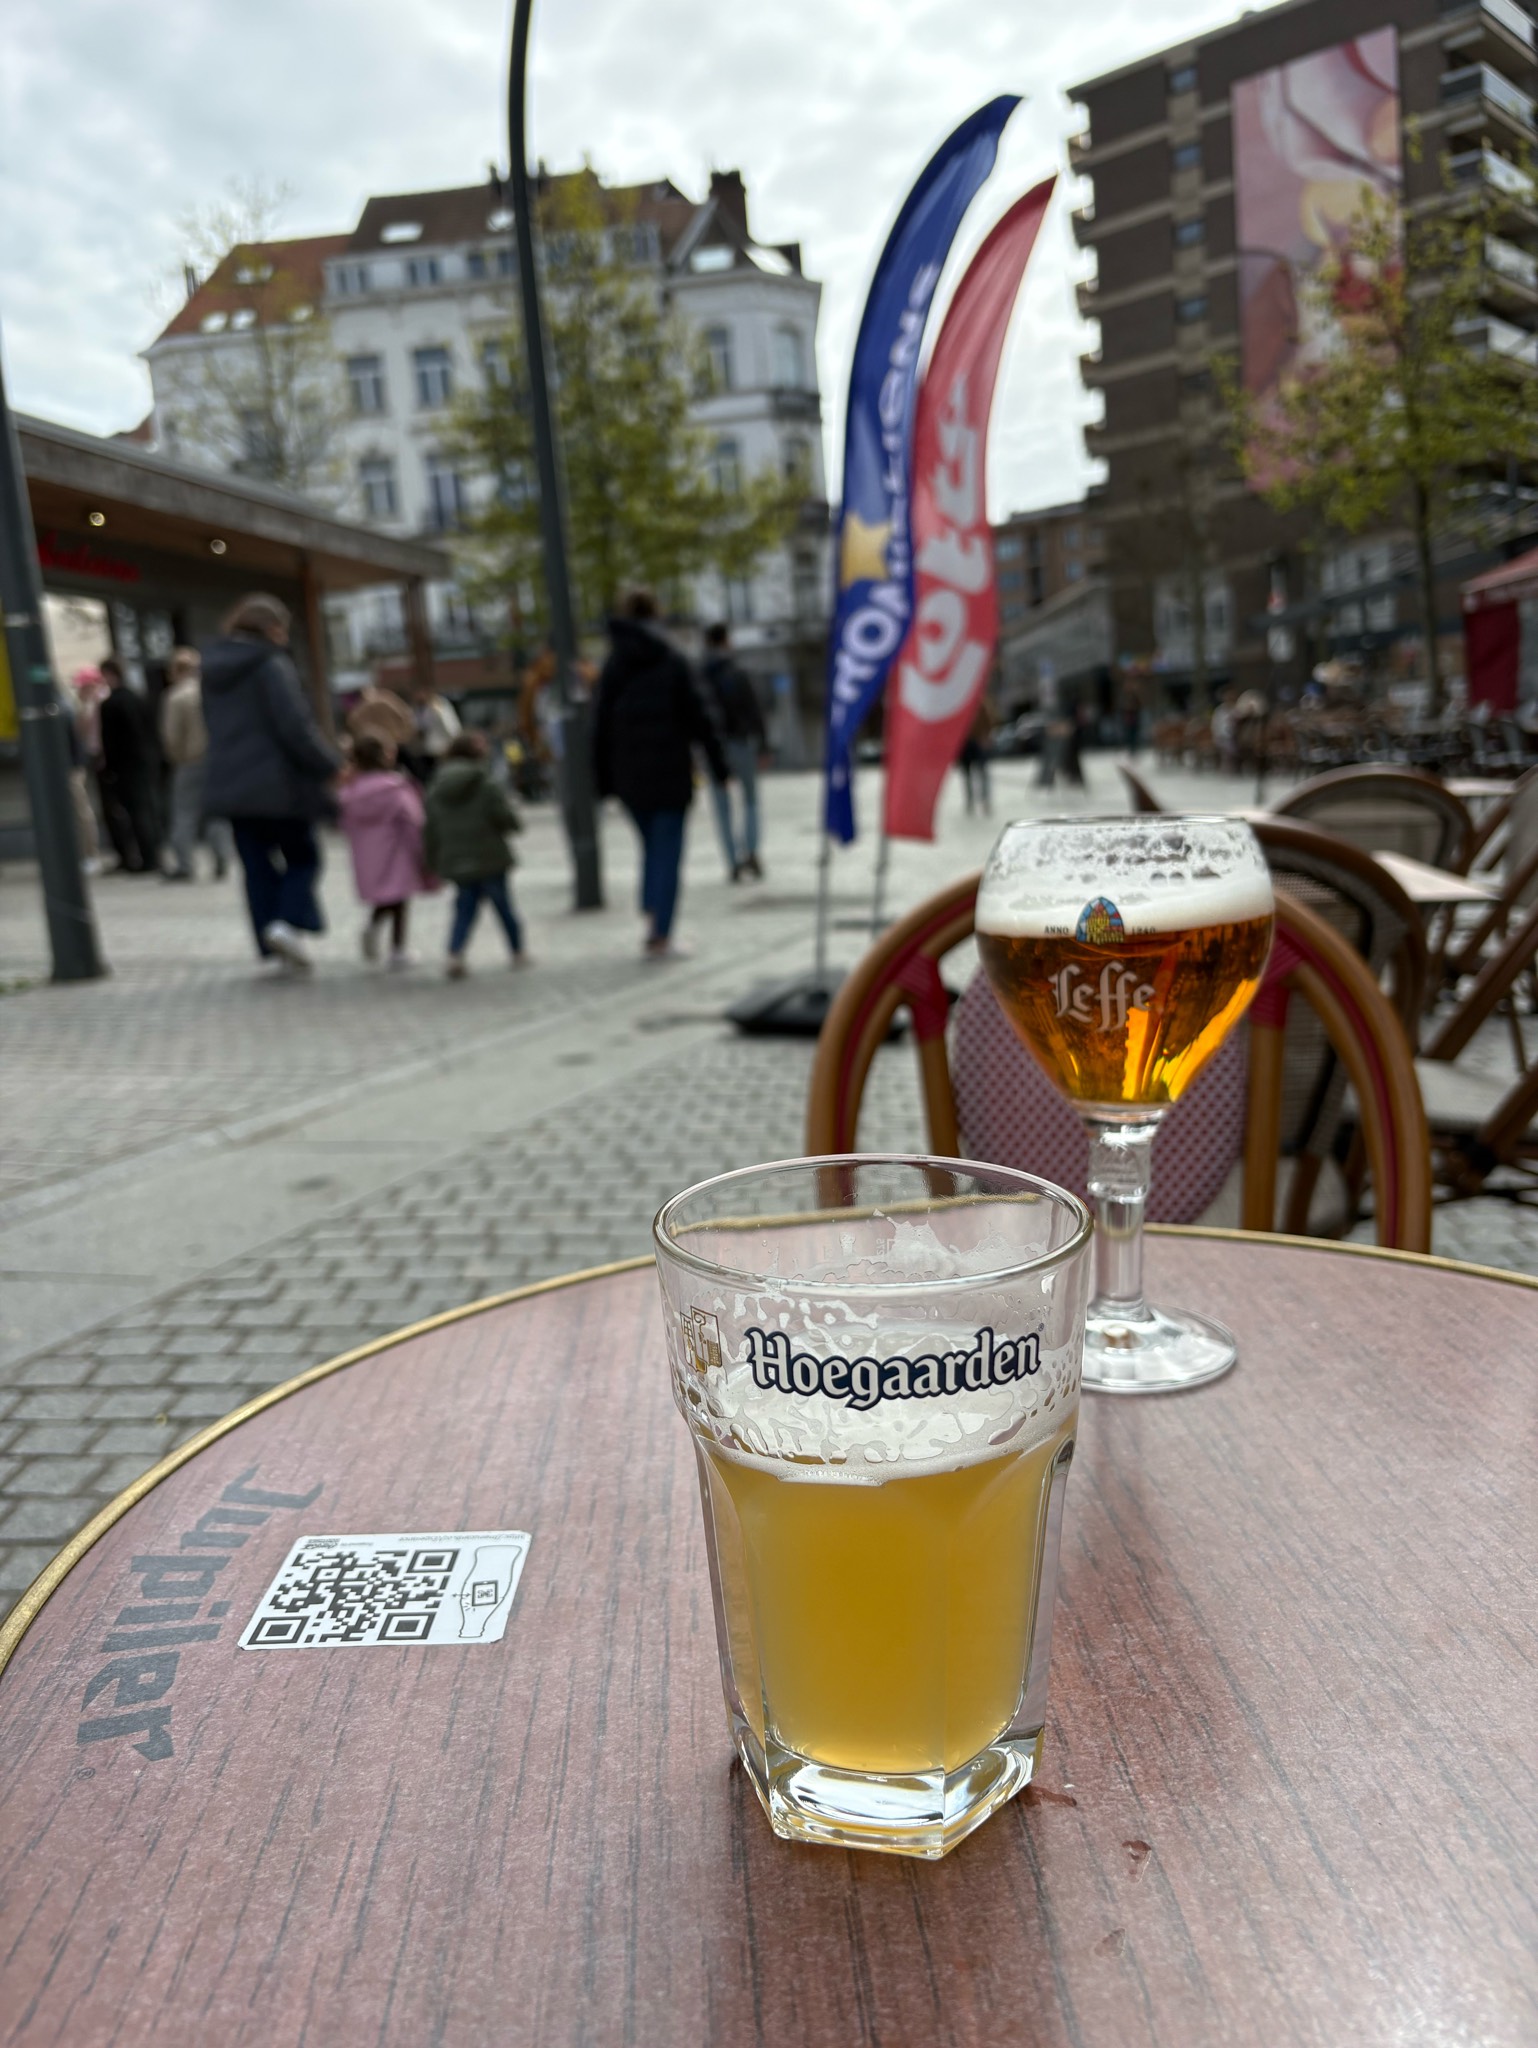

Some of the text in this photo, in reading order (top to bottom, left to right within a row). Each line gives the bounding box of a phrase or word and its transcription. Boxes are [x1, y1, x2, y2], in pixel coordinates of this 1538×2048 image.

[1044, 925, 1070, 934] ANNO
[1047, 960, 1157, 1032] Leffe
[744, 1326, 1042, 1411] Hoegaarden
[76, 1464, 324, 1763] Jupiler
